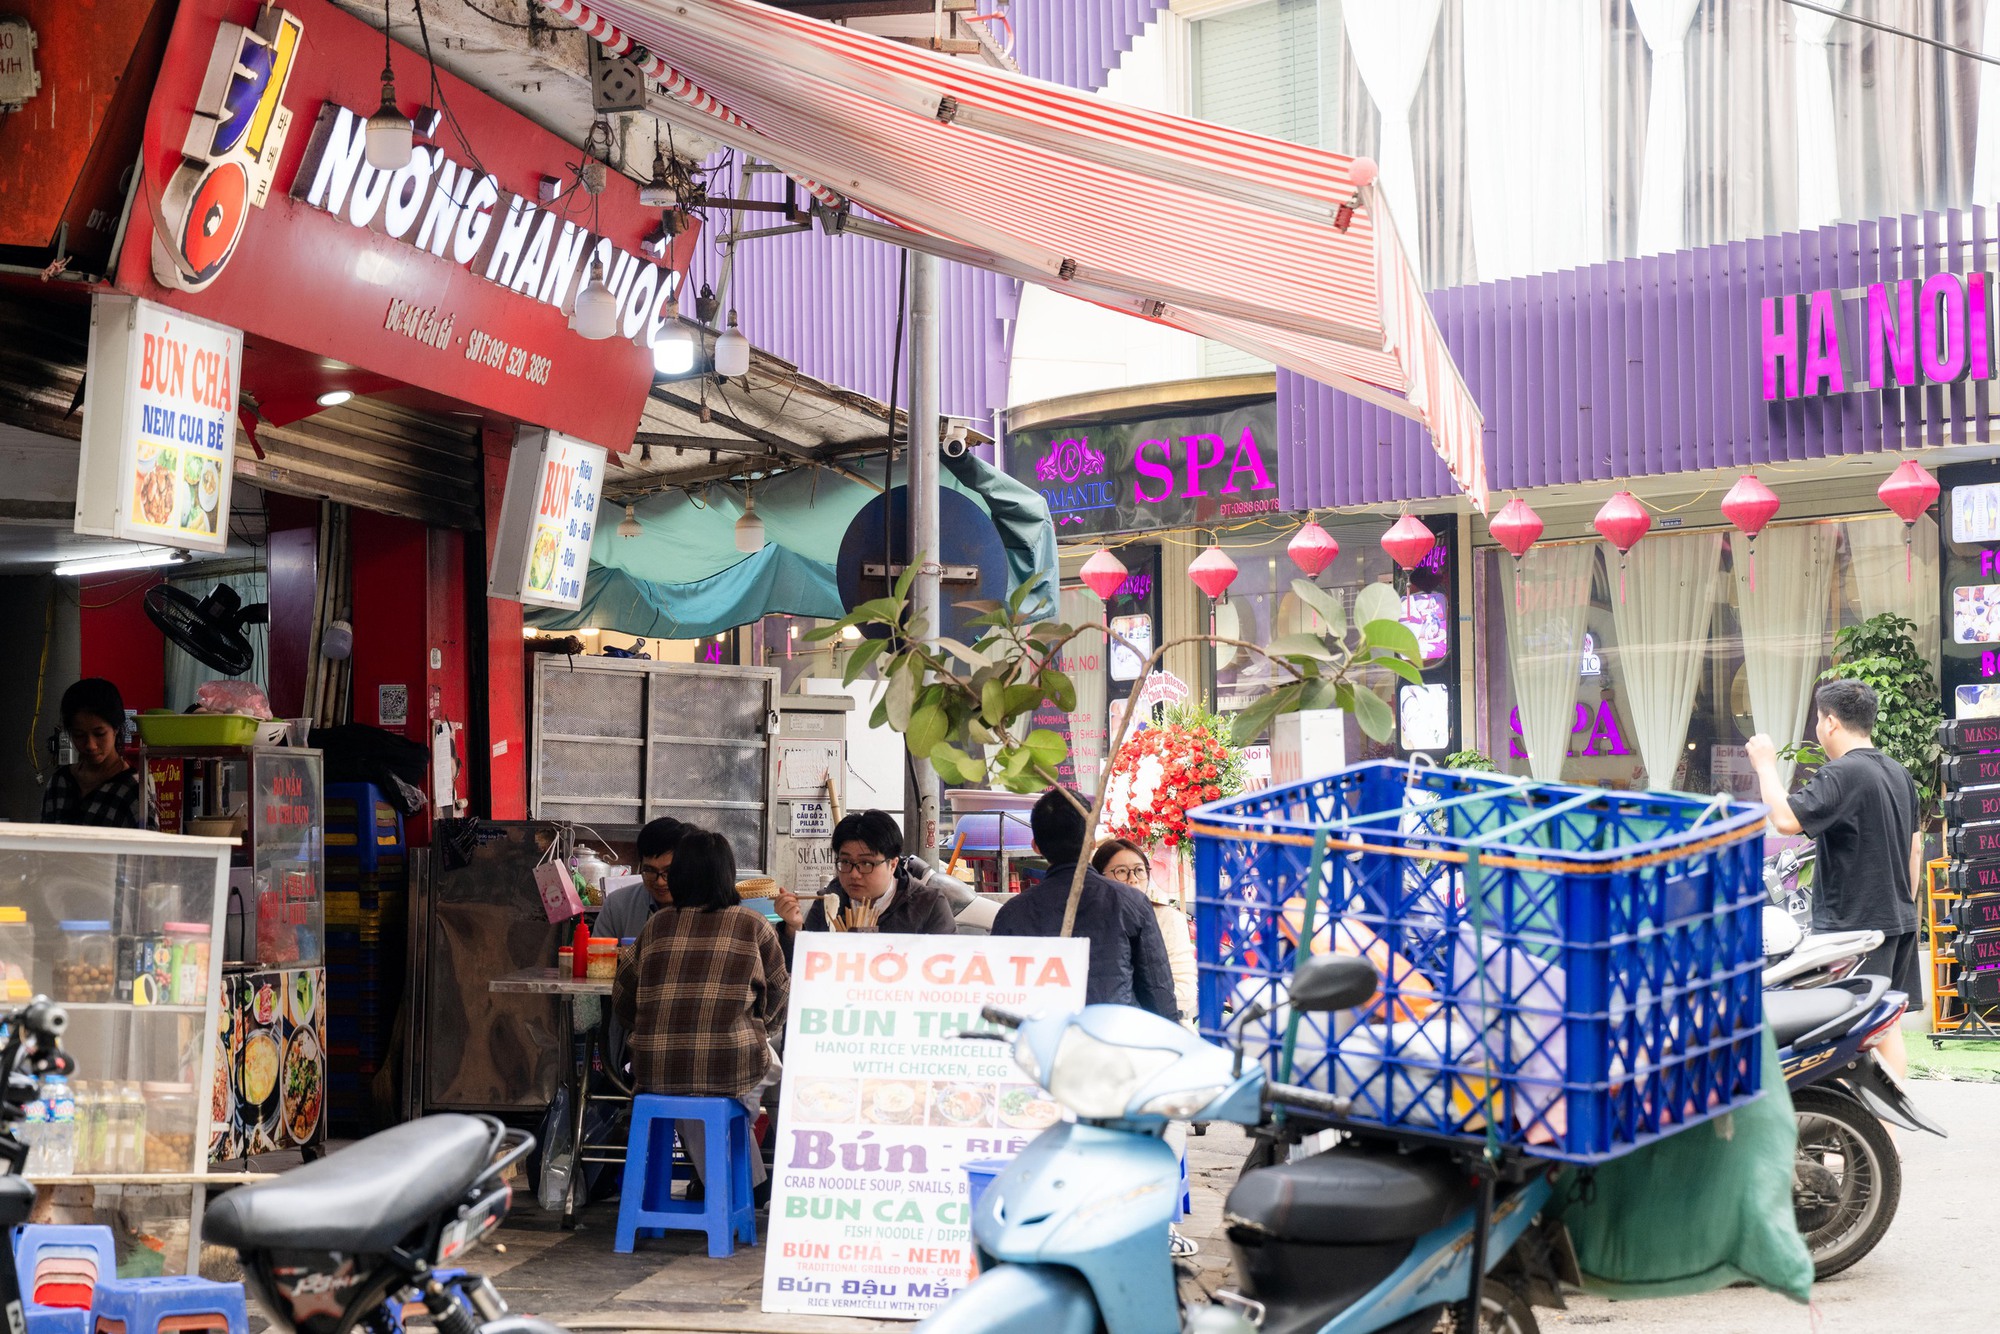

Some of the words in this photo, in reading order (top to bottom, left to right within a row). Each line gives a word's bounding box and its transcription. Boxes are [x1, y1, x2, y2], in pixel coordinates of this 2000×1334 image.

[1761, 288, 1845, 401] HA
[1867, 271, 1989, 389] NOI
[140, 321, 187, 399] BÚN
[192, 337, 231, 412] CHẢ
[465, 329, 508, 370] SĐT:091
[505, 346, 527, 378] 520
[525, 353, 552, 386] 3883
[142, 404, 175, 439] NEM
[178, 414, 203, 446] CUA
[1134, 426, 1275, 504] SPA
[540, 448, 575, 520] BÚN
[1040, 480, 1113, 508] OMANTIC
[1254, 500, 1269, 512] 600
[1981, 651, 2000, 677] B
[1964, 726, 2000, 742] MASS
[1243, 748, 1261, 760] Noi
[820, 847, 833, 864] NH
[1979, 869, 2000, 885] WA
[1983, 906, 2000, 921] TA
[804, 945, 908, 984] PHỞ
[921, 951, 995, 986] GÀ
[1009, 956, 1071, 988] TA
[847, 988, 914, 1002] CHICKEN
[919, 991, 980, 1004] NOODLE
[986, 992, 1027, 1005] SOUP
[799, 1004, 896, 1036] BÚN
[815, 1041, 864, 1054] HANOI
[870, 1042, 905, 1055] RICE
[911, 1044, 1002, 1058] VERMICELLI
[1008, 1045, 1015, 1058] S
[852, 1061, 894, 1073] WITH
[899, 1062, 971, 1077] CHICKEN,
[977, 1064, 1007, 1077] EGG
[787, 1129, 929, 1174] Bún
[966, 1136, 1028, 1153] RIÊ
[784, 1175, 815, 1188] CRAB
[818, 1177, 866, 1191] NOODLE
[869, 1179, 904, 1194] SOUP,
[908, 1181, 954, 1195] SNAILS,
[844, 1225, 872, 1238] FISH
[876, 1226, 924, 1240] NOODLE
[937, 1230, 971, 1243] DIPPI
[783, 1240, 829, 1259] BÚN
[838, 1241, 882, 1261] CHẢ
[908, 1247, 960, 1264] NEM
[797, 1262, 858, 1273] TRADITIONAL
[861, 1264, 900, 1275] GRILLED
[903, 1265, 928, 1276] PORK
[937, 1267, 961, 1277] CARB
[778, 1277, 831, 1293] Bún
[841, 1279, 896, 1298] Đậu
[808, 1298, 829, 1307] RICE
[832, 1299, 886, 1309] VERMICELLI
[890, 1301, 915, 1310] WITH
